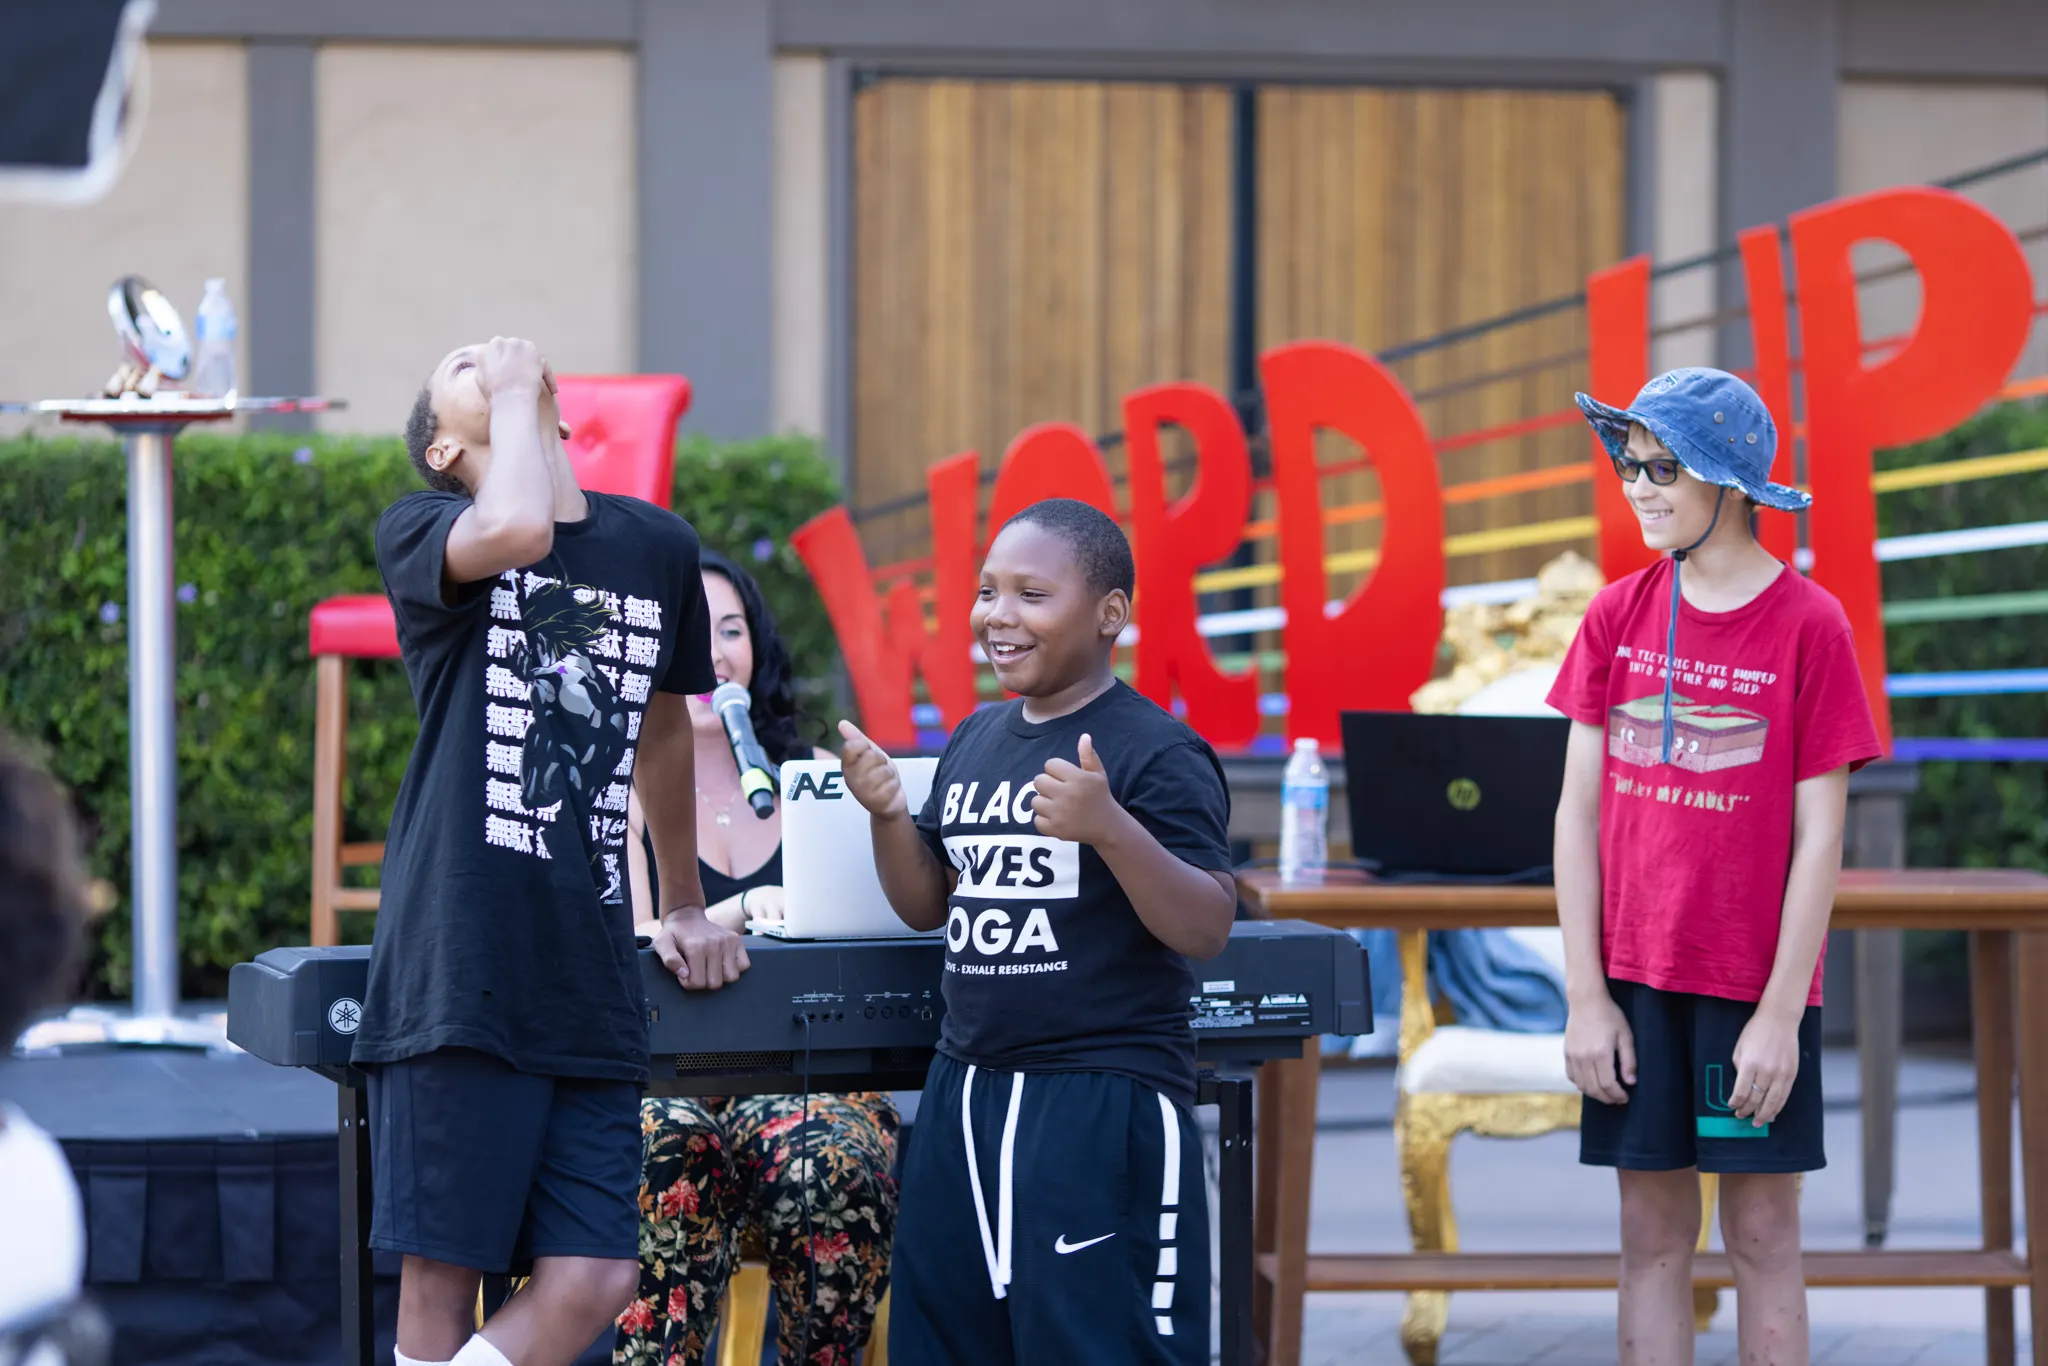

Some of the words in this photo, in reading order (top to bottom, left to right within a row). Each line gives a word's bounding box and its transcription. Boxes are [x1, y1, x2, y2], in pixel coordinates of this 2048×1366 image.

[941, 781, 1040, 827] BLAC
[951, 844, 1055, 888] IVES
[945, 906, 1060, 956] OGA
[961, 964, 996, 975] EXHALE
[998, 960, 1068, 975] RESISTANCE
